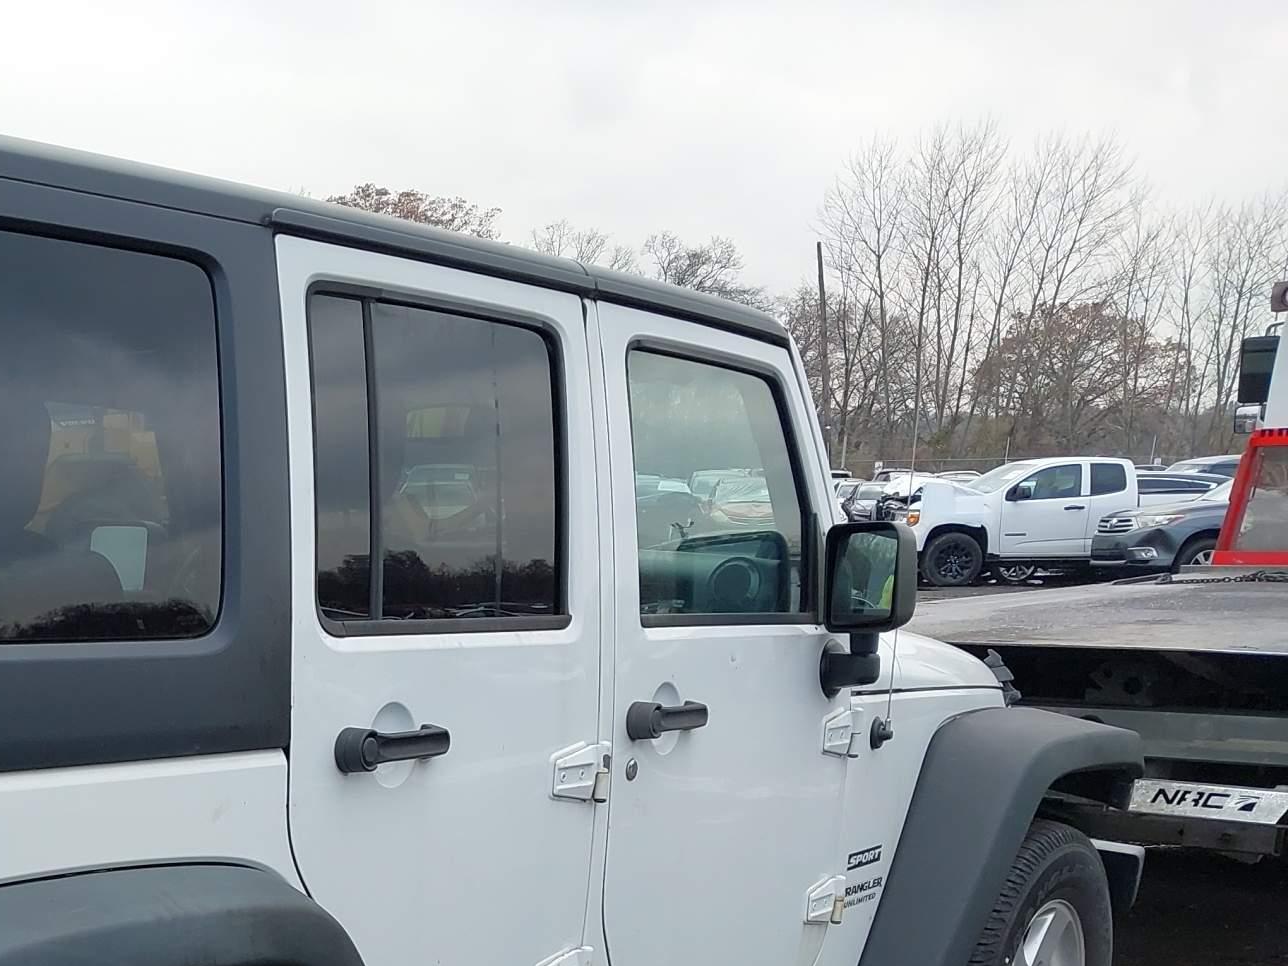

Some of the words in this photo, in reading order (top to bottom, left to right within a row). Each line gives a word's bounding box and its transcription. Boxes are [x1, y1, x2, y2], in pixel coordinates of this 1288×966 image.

[1150, 788, 1232, 809] NRC
[848, 848, 881, 868] SPORT
[845, 877, 883, 897] RANGLER
